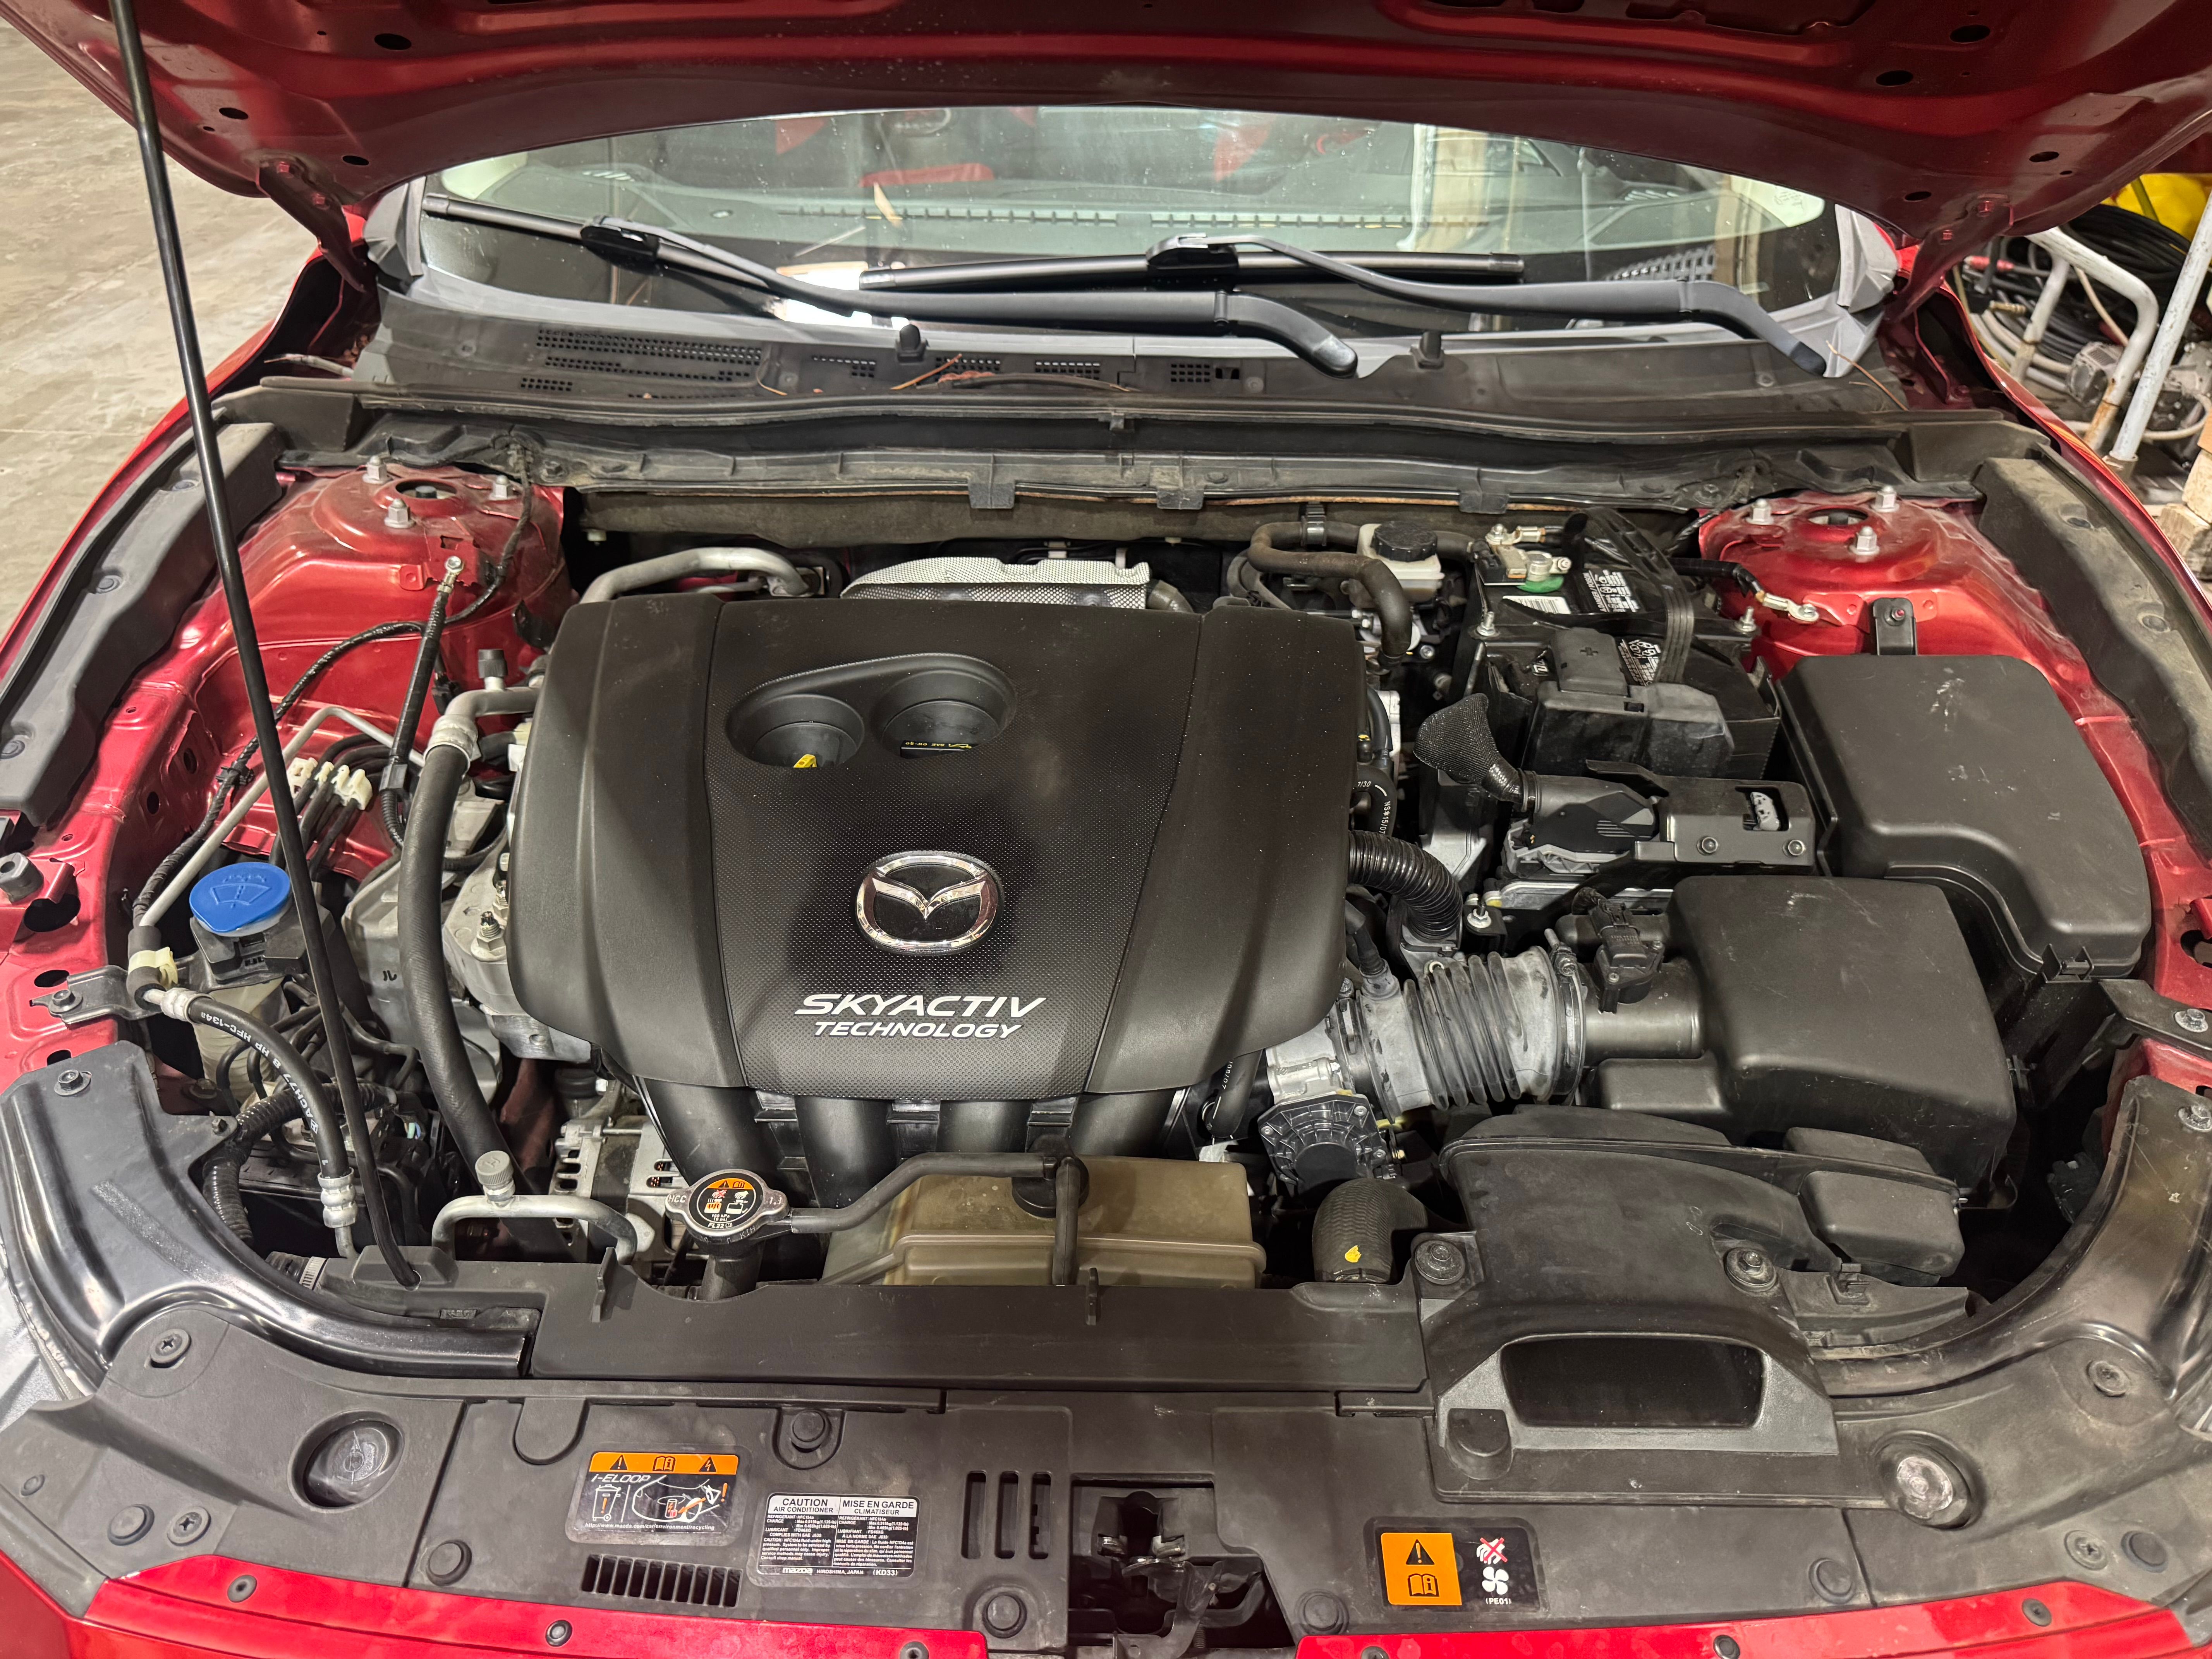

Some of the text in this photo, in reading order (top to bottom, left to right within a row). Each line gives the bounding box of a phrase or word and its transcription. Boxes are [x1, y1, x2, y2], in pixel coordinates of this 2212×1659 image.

[795, 994, 1046, 1018] SKYACTIV
[201, 1012, 251, 1042] HFC-134a
[814, 1021, 1023, 1039] TECHNOLOGY
[783, 1498, 828, 1506] CAUTION
[585, 1522, 715, 1531] http://www.mazda.com/csr/environment/recycling
